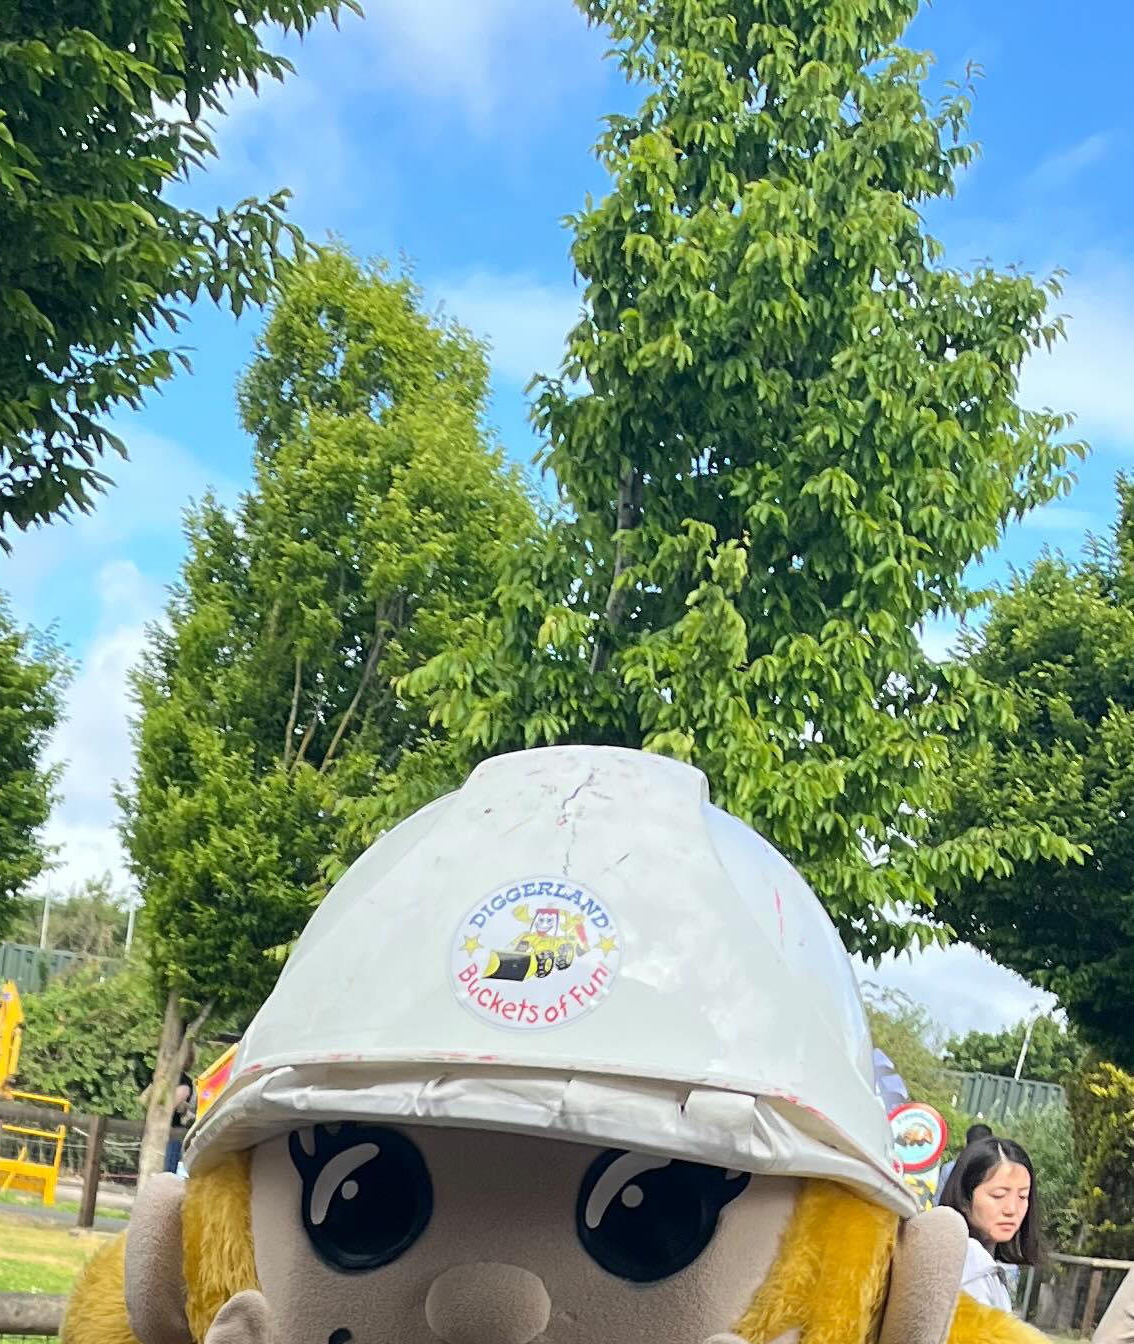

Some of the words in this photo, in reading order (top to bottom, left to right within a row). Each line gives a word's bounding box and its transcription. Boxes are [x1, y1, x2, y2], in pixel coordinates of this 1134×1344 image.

[469, 882, 609, 929] DIGGERLAND
[458, 962, 539, 1023] Buckets
[544, 995, 568, 1022] of
